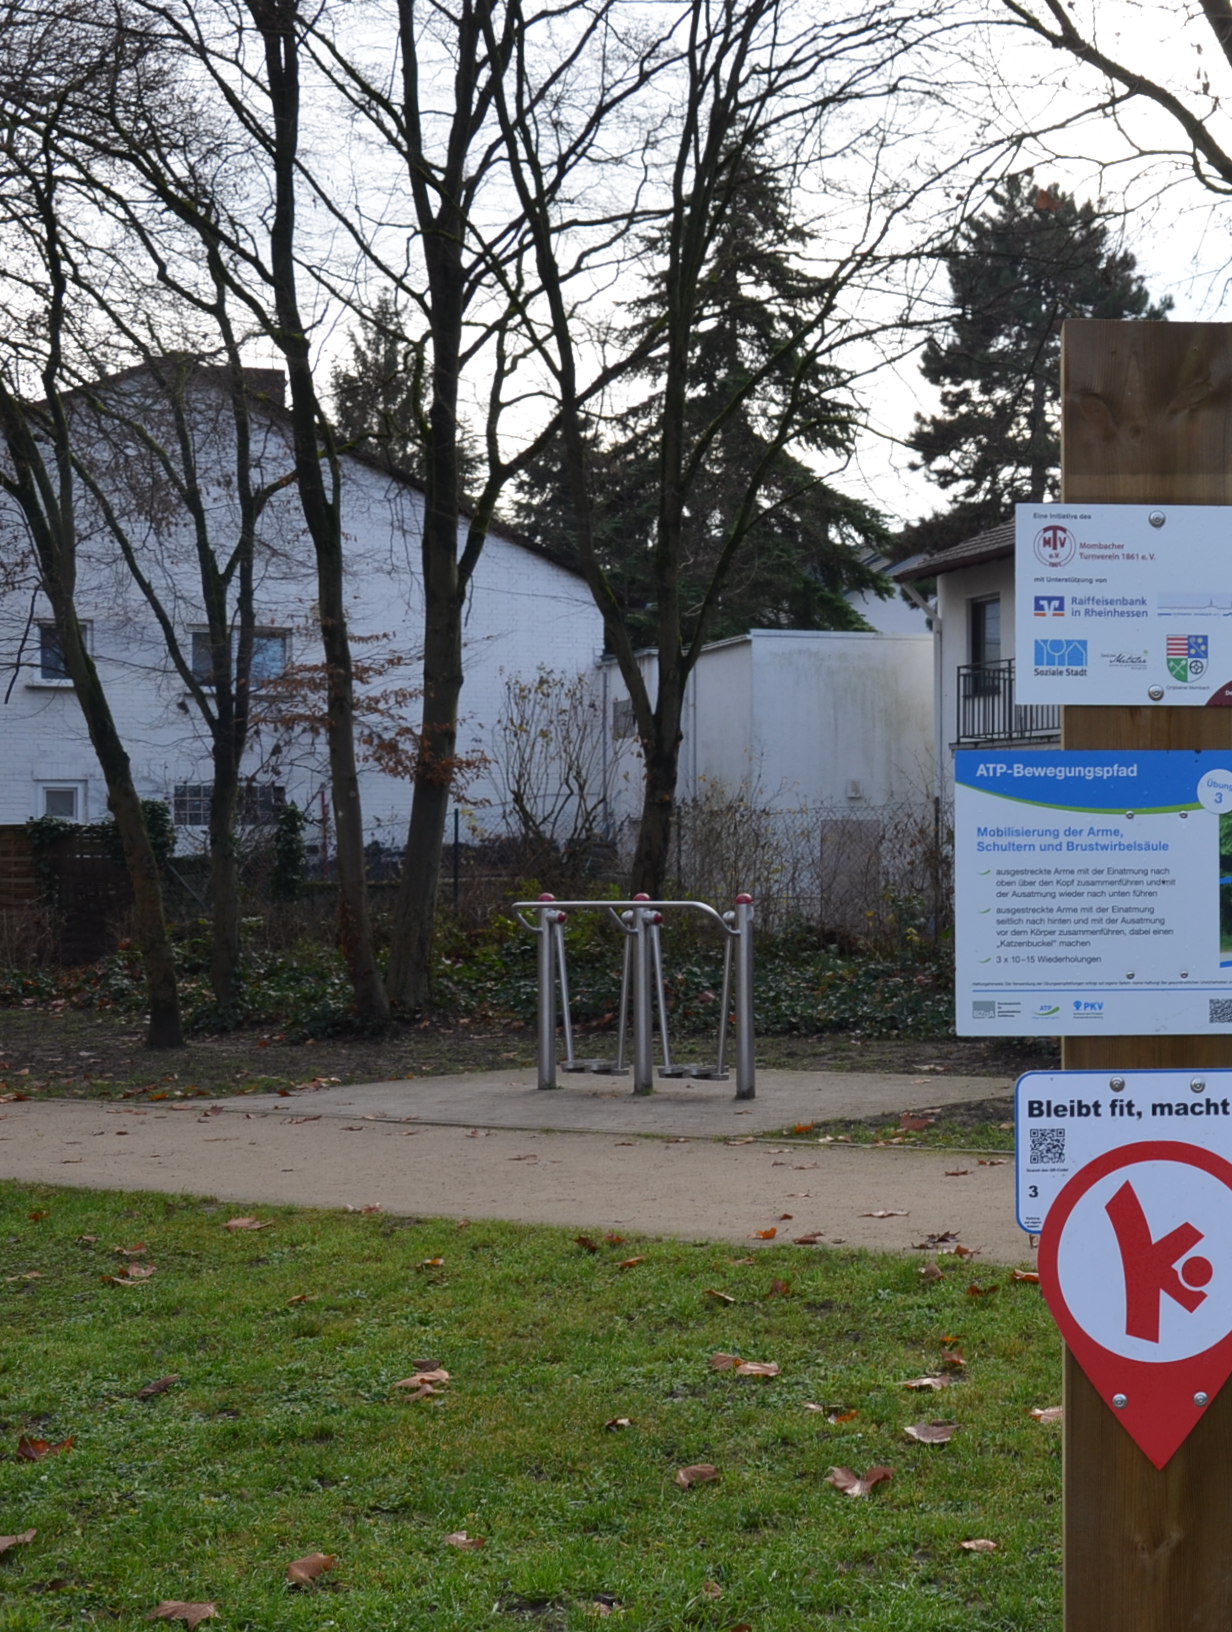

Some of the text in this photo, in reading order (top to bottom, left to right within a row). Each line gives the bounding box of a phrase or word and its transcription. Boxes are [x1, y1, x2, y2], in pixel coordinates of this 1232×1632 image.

[1079, 541, 1124, 551] Mombacher
[1070, 595, 1148, 607] Raiffeisenbank
[1071, 607, 1149, 618] in Rheinhessen
[1034, 667, 1088, 677] Soziale Stadt
[975, 763, 1139, 781] ATP-Bewegungspfad
[1214, 792, 1223, 804] 3
[975, 826, 1125, 840] Mobilisierung der Arme,
[975, 840, 1170, 853] Schultern und Brustwirbelsäule
[995, 867, 1170, 878] ausgestreckte Arme mit der Einatmung nach
[996, 879, 1016, 888] oben
[1019, 879, 1036, 888] über
[1039, 879, 1054, 888] den
[1056, 879, 1075, 889] Kopf
[1077, 878, 1144, 888] zusammenführen
[1147, 879, 1161, 888] und
[996, 889, 1158, 900] der Ausatmung wieder nach unten führen
[995, 904, 1156, 916] ausgestreckte Arme mit der Einatmung
[996, 916, 1167, 927] seitlich nach hinten und mit der Ausatmung
[996, 927, 1174, 938] vor dem Körper zusammenführen, dabei einen
[1083, 1002, 1104, 1011] PKV
[1027, 1099, 1102, 1119] Bleibt
[1109, 1098, 1142, 1121] fit,
[1151, 1097, 1230, 1117] macht
[1028, 1185, 1039, 1198] 3
